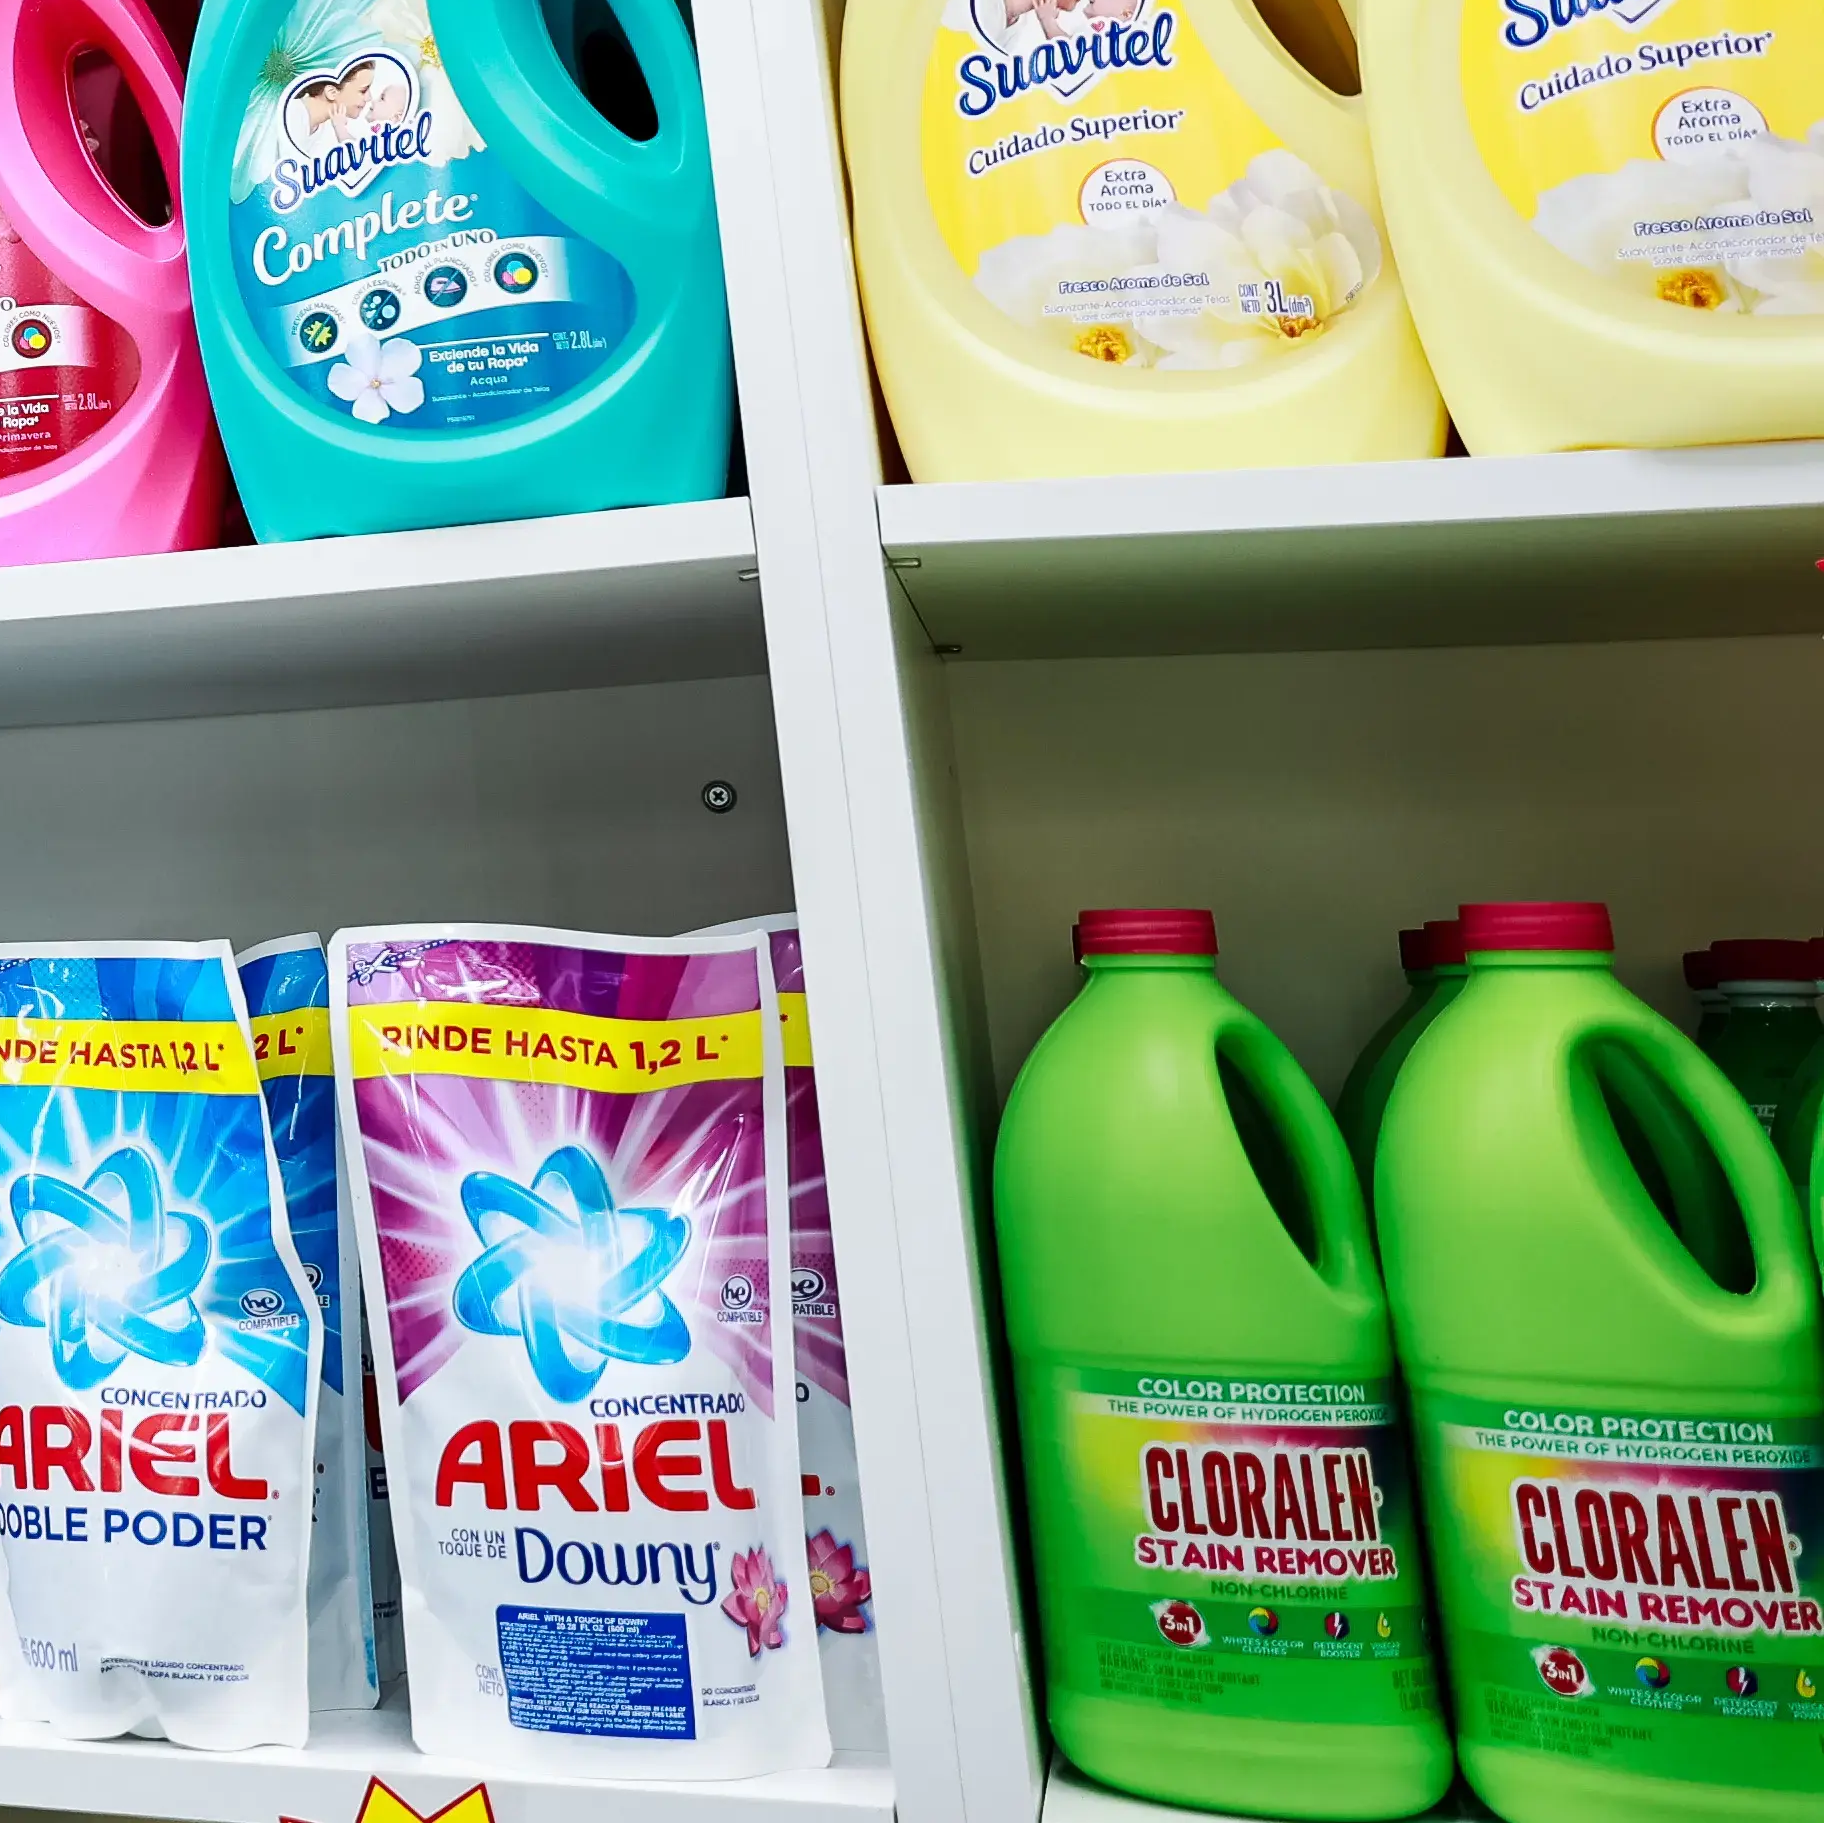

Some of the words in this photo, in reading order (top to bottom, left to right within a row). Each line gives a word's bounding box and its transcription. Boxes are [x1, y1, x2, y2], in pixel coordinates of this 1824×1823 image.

[958, 11, 1175, 118] Suavitel
[1519, 53, 1634, 112] Cuidado
[1675, 111, 1742, 131] Aroma
[1681, 97, 1733, 115] Extra
[268, 110, 435, 213] Suavitel
[968, 125, 1066, 177] Cuidado
[1099, 180, 1154, 197] Aroma
[1103, 168, 1148, 183] Extra
[69, 1039, 169, 1069] HASTA
[382, 1024, 497, 1057] RINDE
[507, 1032, 619, 1069] HASTA
[630, 1039, 683, 1075] 1,2
[101, 1386, 269, 1410] CONCENTRADO
[589, 1394, 747, 1418] CONCENTRADO
[1136, 1377, 1226, 1402] COLOR
[1230, 1382, 1366, 1407] PROTECTION
[1503, 1409, 1597, 1437] COLOR
[1600, 1415, 1775, 1445] PROTECTION
[434, 1418, 756, 1514] ARIEL
[1148, 1445, 1379, 1544] CLORALEN
[438, 1541, 488, 1560] TOQUE
[490, 1544, 508, 1560] DE
[451, 1528, 483, 1545] CON
[485, 1531, 506, 1546] UN
[1517, 1480, 1795, 1595] CLORALEN
[515, 1525, 719, 1605] Downy
[1135, 1536, 1249, 1572] STAIN
[1255, 1544, 1397, 1580] REMOVER
[1210, 1580, 1350, 1603] NON-CHLORINE
[1513, 1582, 1635, 1622] STAIN
[1591, 1627, 1756, 1656] NON-CHLORINE
